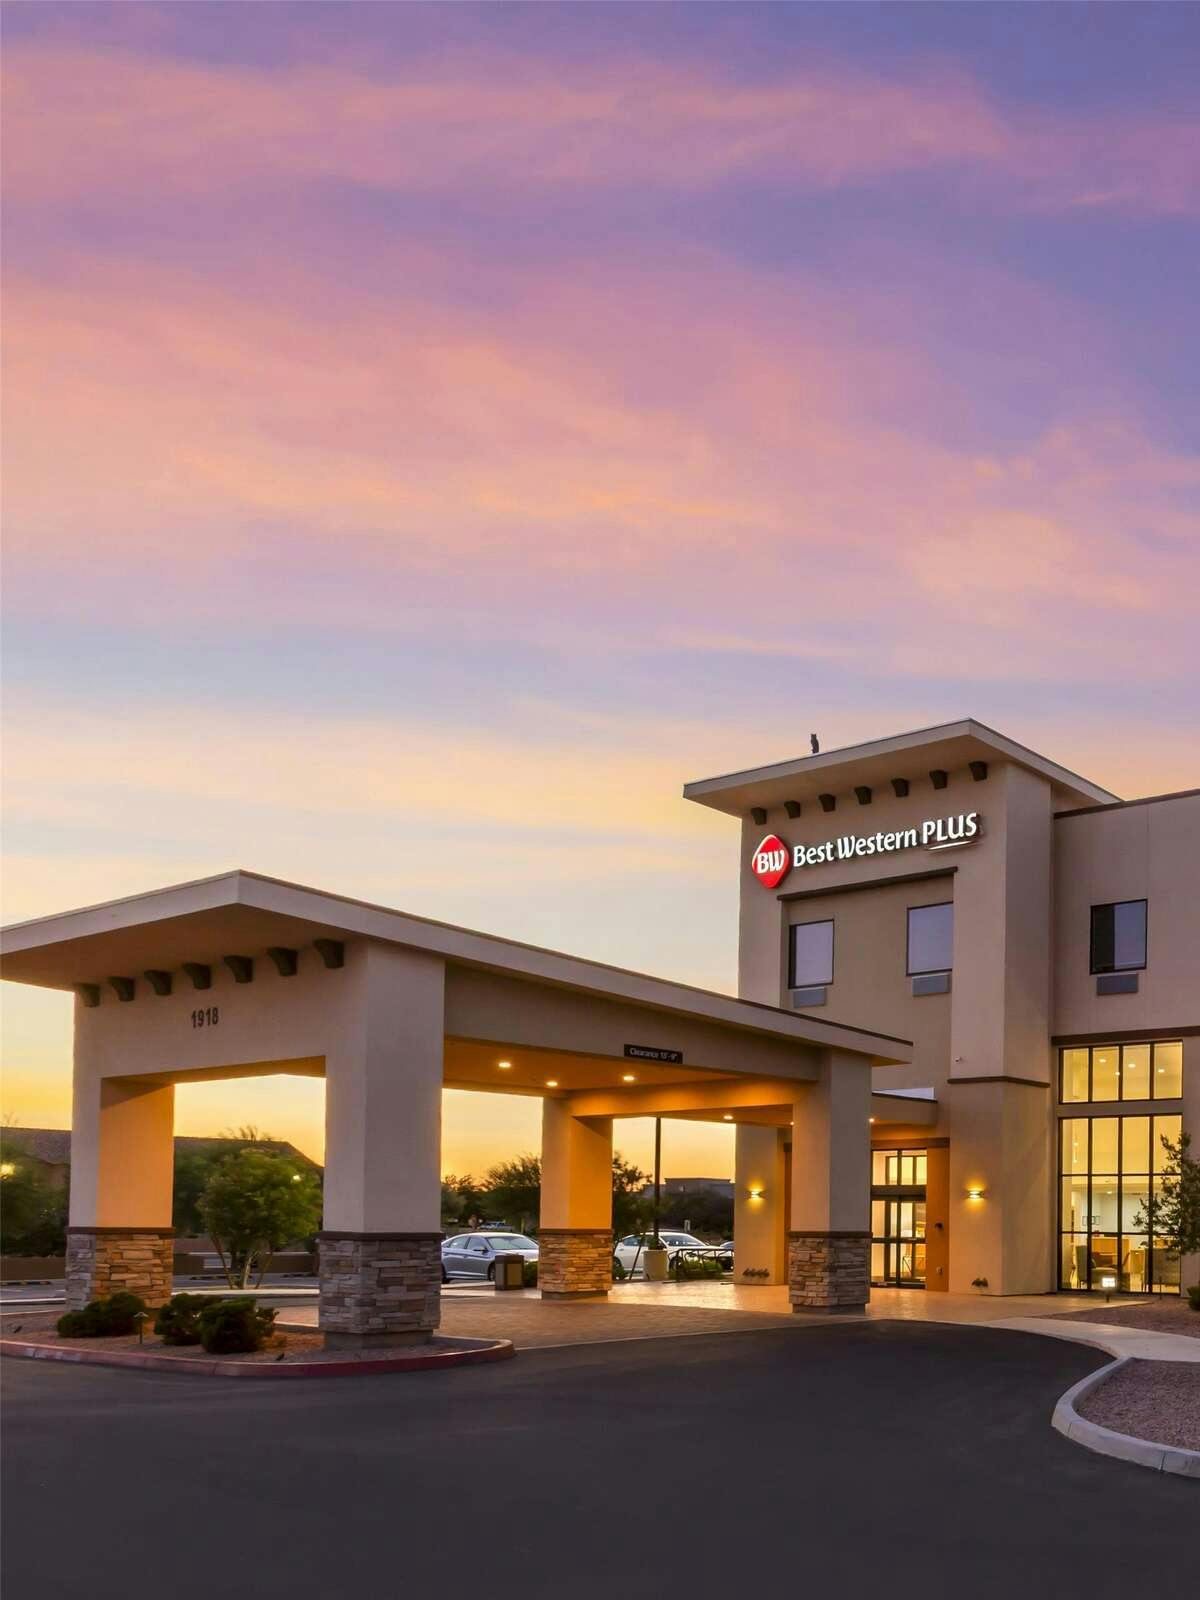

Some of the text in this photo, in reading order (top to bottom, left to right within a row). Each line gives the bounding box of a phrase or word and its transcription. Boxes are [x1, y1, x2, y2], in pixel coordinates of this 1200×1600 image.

[793, 812, 977, 867] Best Western PLUS
[756, 850, 785, 874] BW
[191, 1007, 219, 1028] 1918
[629, 1047, 659, 1059] Clearance
